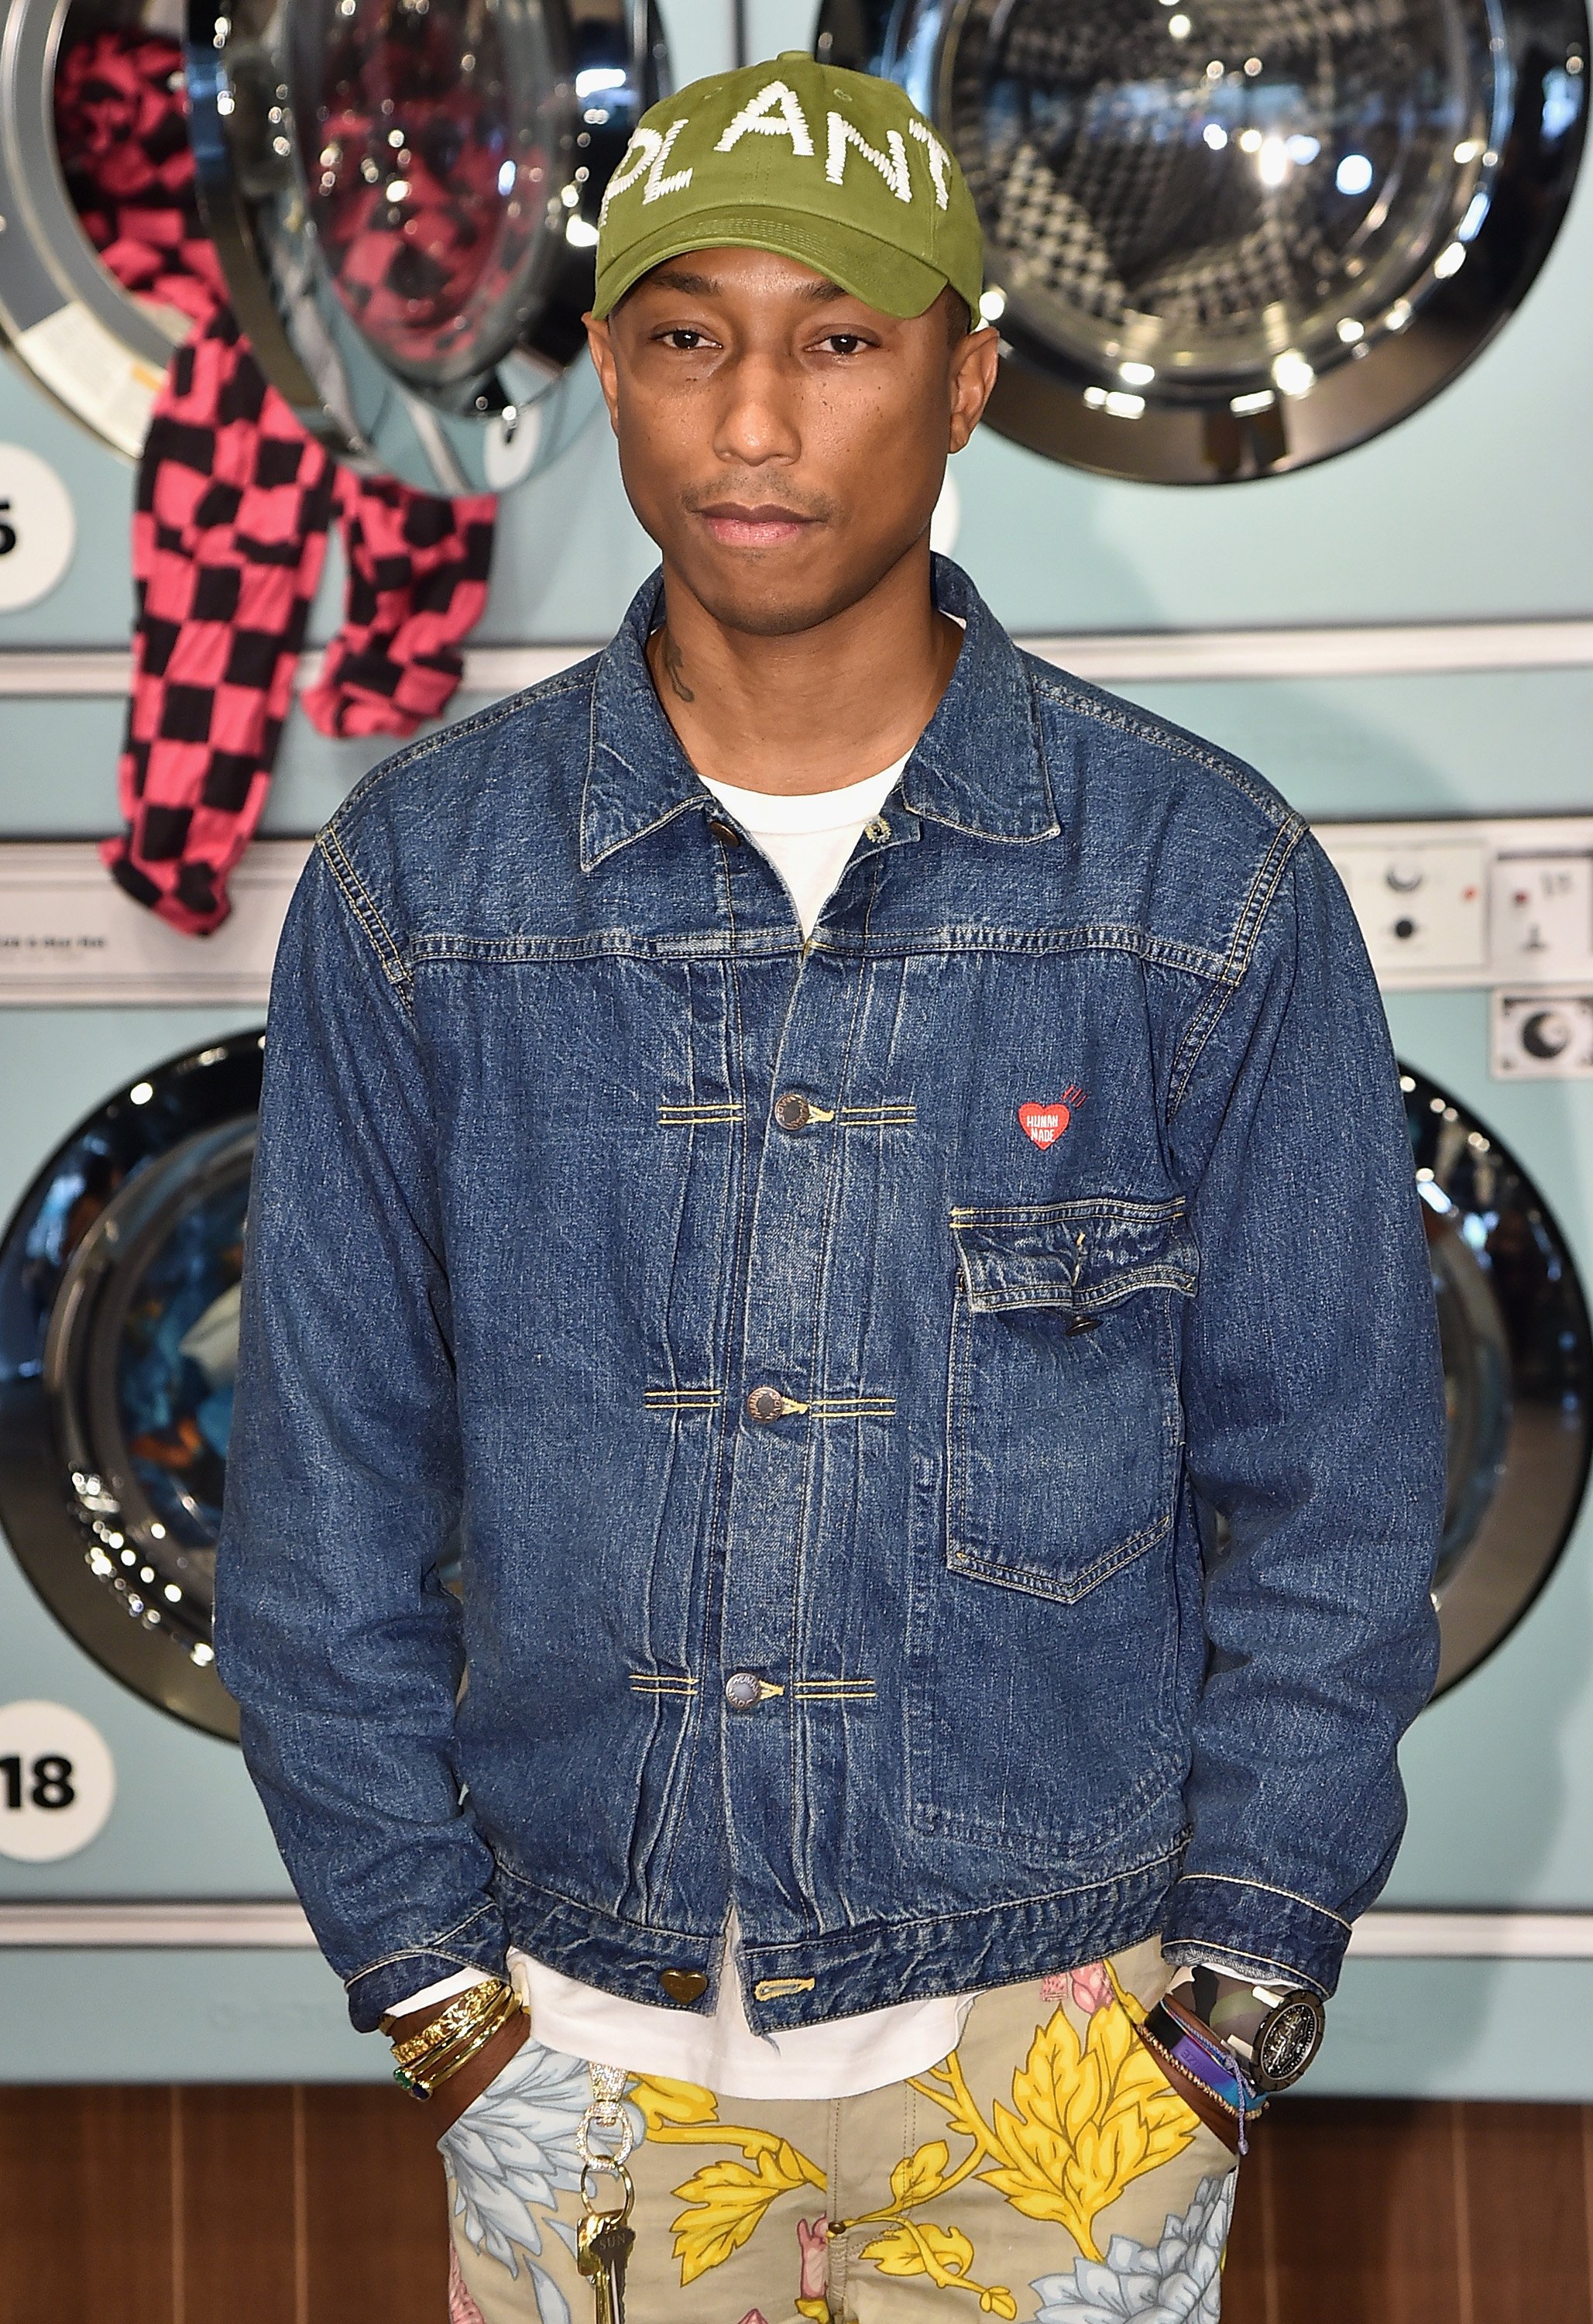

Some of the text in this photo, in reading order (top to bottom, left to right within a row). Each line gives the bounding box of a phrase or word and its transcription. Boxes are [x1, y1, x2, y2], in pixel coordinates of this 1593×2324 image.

[599, 80, 952, 229] PLANT
[1026, 1115, 1059, 1128] HUMAN
[1031, 1128, 1056, 1142] MADE
[0, 1756, 75, 1808] 18
